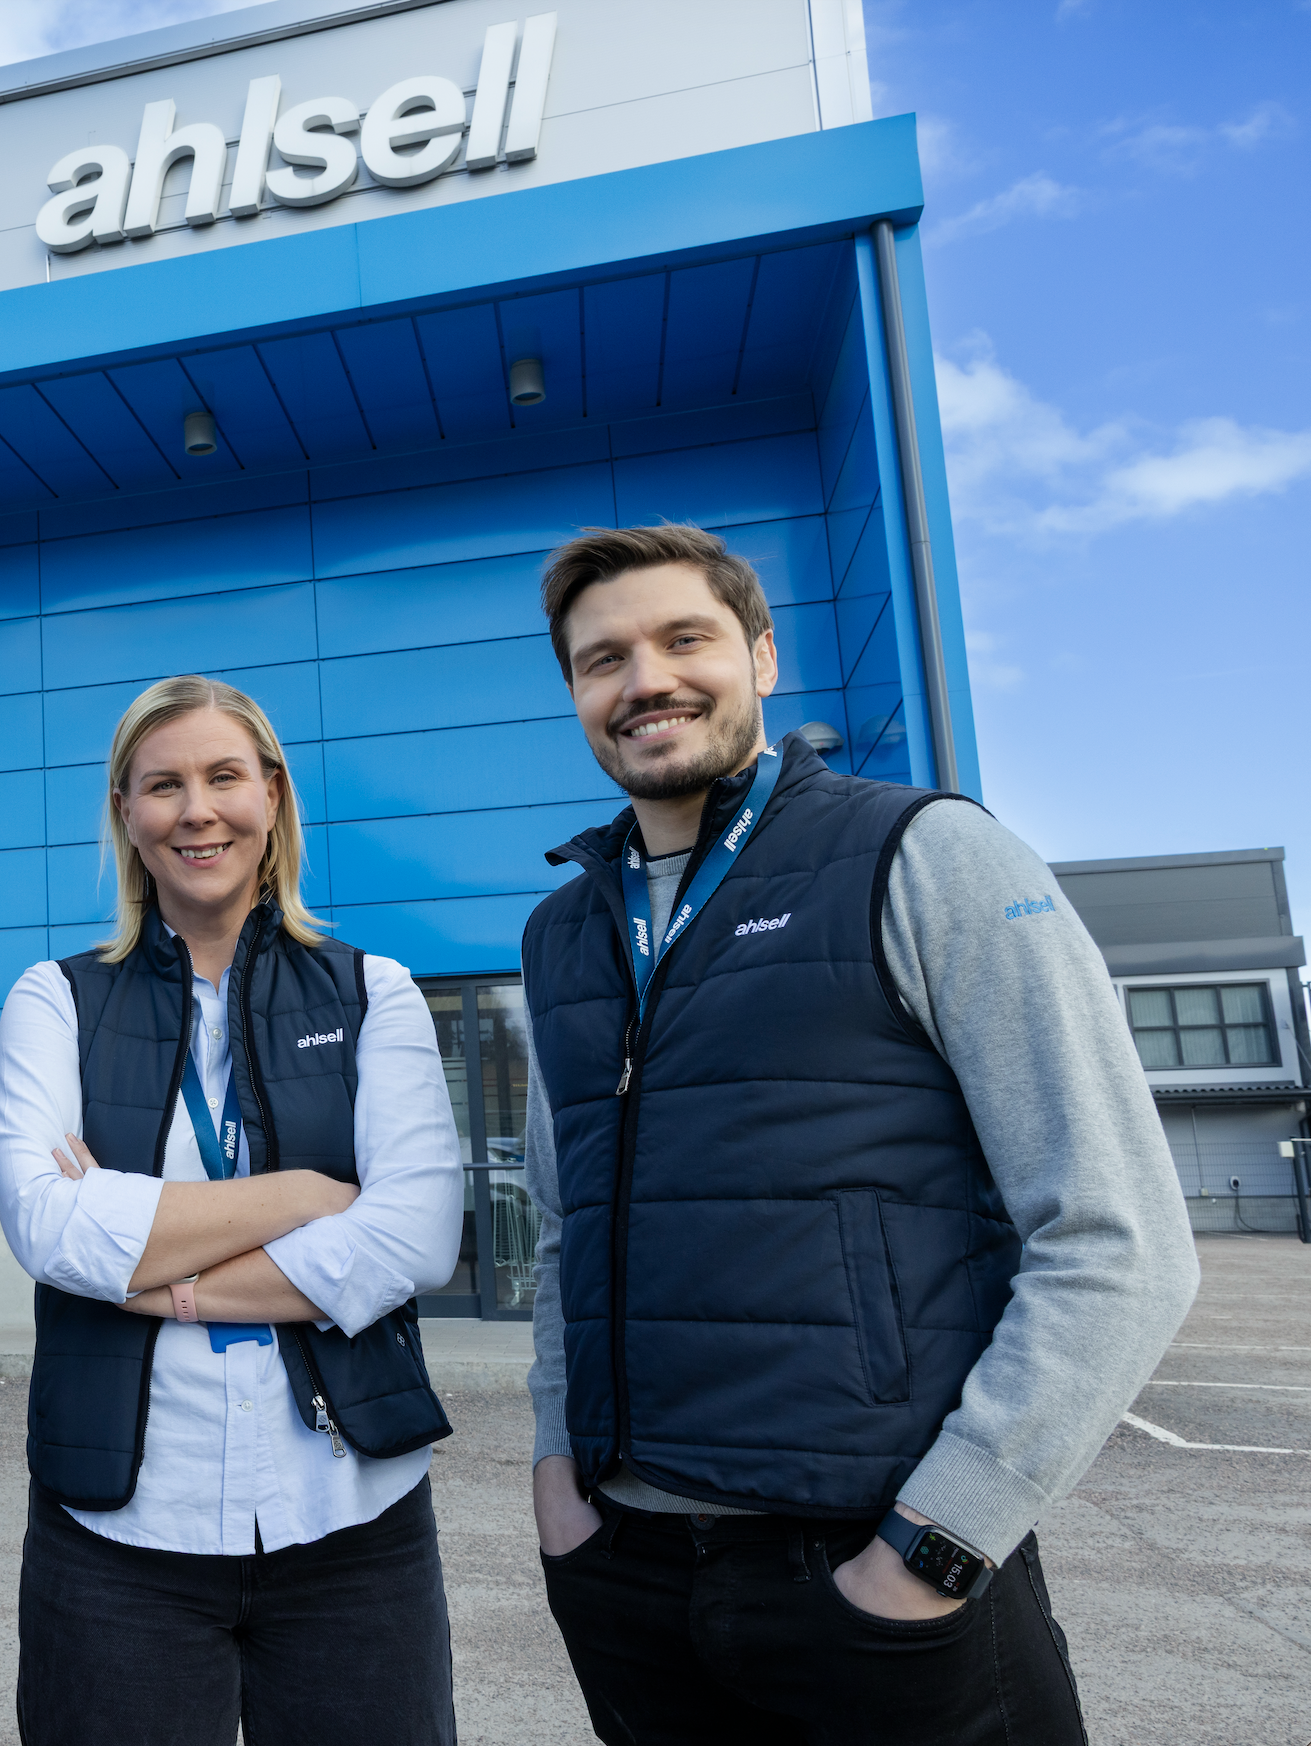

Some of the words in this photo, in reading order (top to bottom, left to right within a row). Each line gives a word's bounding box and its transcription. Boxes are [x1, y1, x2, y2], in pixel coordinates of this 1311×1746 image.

[36, 11, 557, 253] ahlsell
[723, 808, 753, 852] ahlsell
[665, 904, 692, 944] ahlsell
[734, 913, 791, 936] ahlsell
[1005, 894, 1056, 920] ahlsell
[633, 917, 650, 956] ahlsell
[297, 1028, 343, 1048] ahlsell
[224, 1121, 236, 1159] ahlsell
[943, 1563, 963, 1588] 15.03
